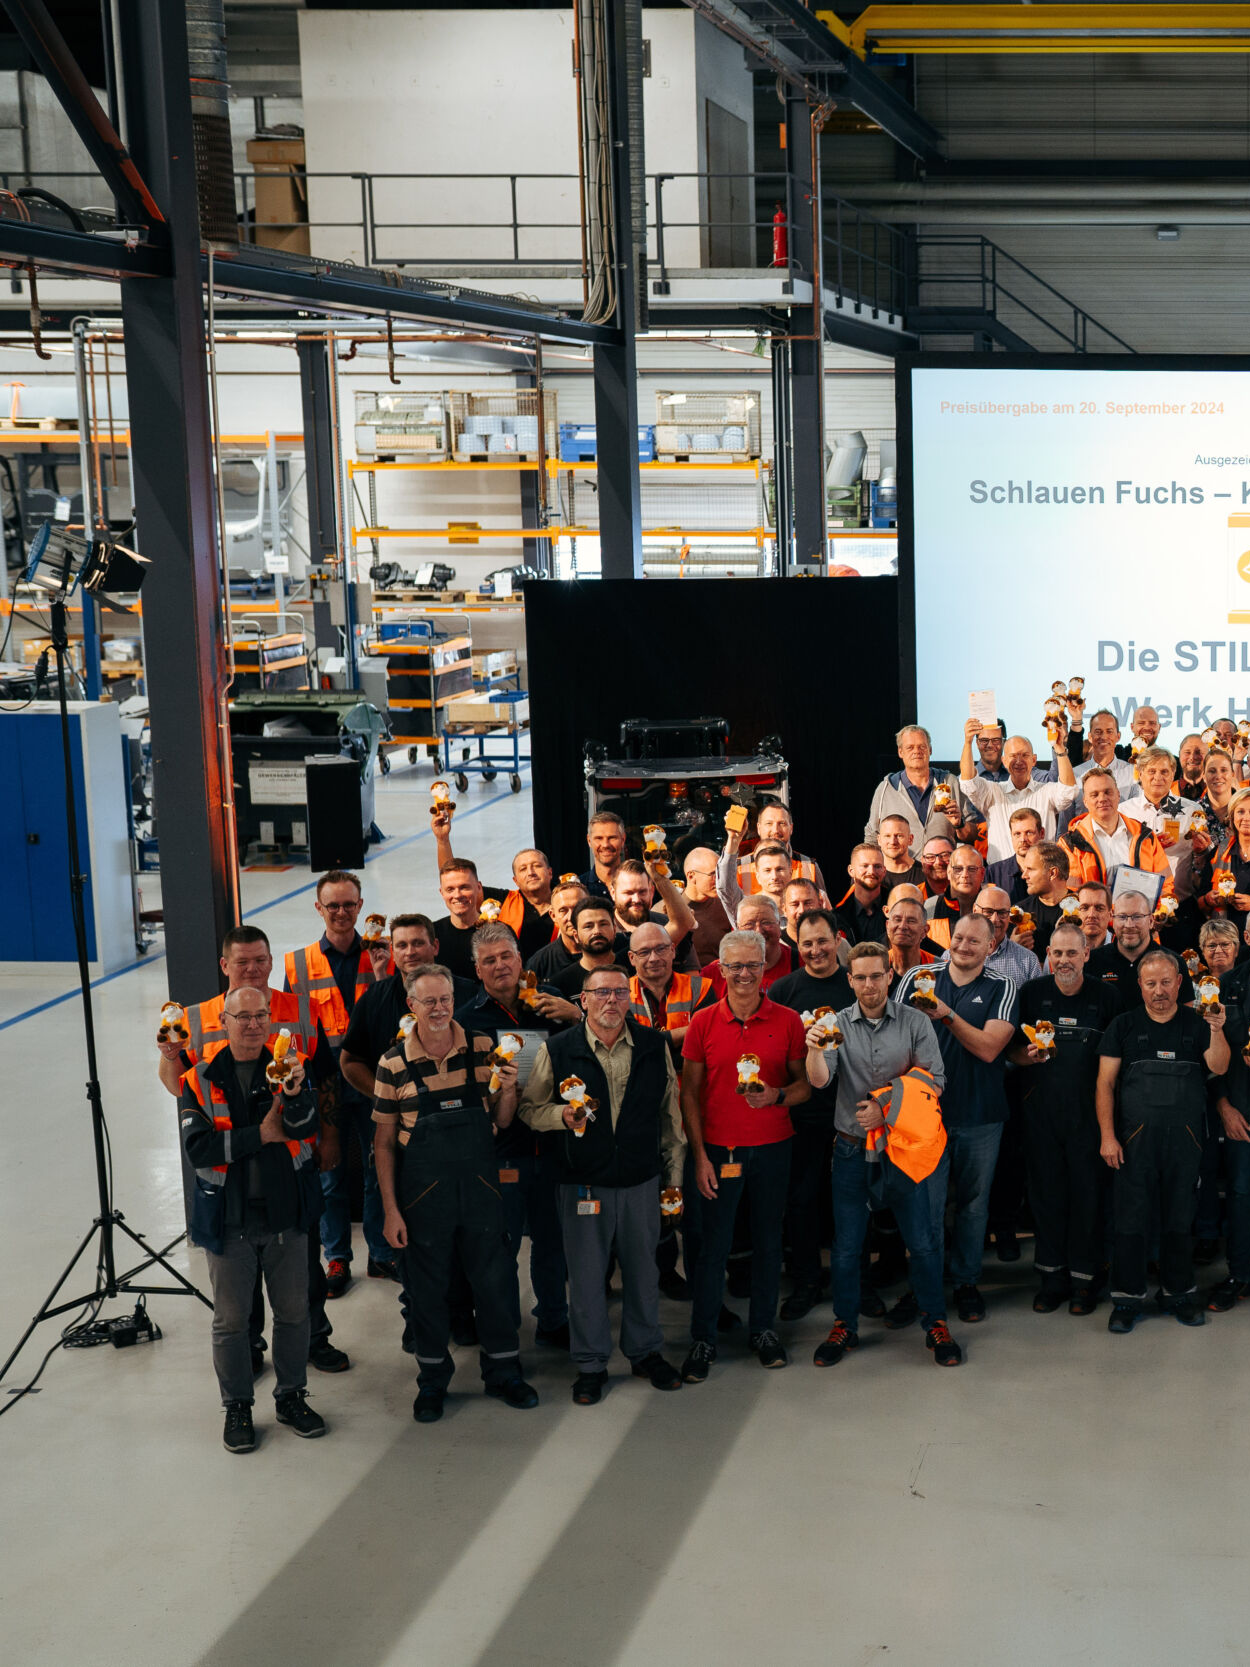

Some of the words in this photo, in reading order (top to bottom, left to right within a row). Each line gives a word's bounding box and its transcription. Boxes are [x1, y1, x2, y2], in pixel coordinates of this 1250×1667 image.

[941, 400, 1048, 417] Preisübergabe
[1053, 404, 1075, 415] am
[1080, 401, 1100, 415] 20.
[1106, 400, 1187, 418] September
[1191, 401, 1224, 415] 2024
[970, 479, 1105, 505] Schlauen
[1116, 480, 1204, 505] Fuchs
[1098, 640, 1160, 673] Die
[1112, 696, 1213, 728] Werk
